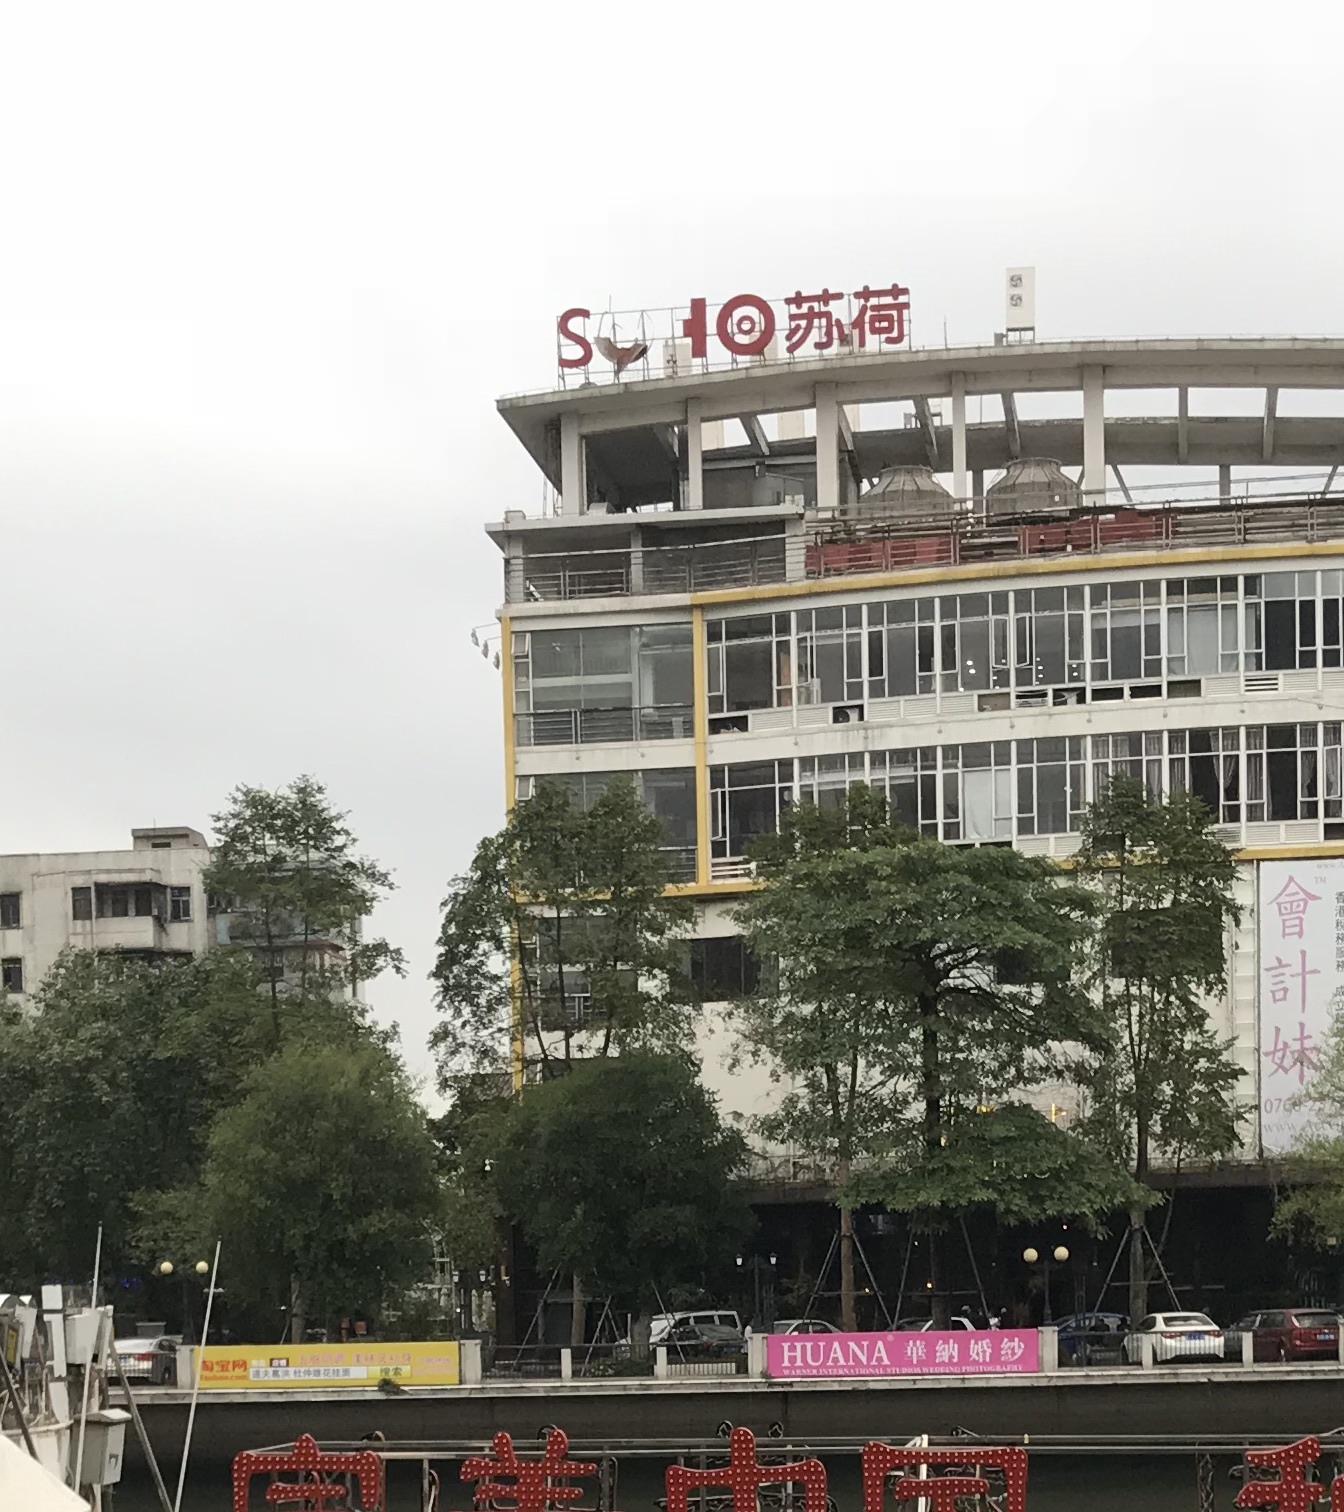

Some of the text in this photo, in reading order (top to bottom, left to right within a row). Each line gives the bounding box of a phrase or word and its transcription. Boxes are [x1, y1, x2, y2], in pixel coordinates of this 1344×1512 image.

[783, 283, 910, 354] 苏荷
[1262, 874, 1324, 1086] 會計妹
[781, 1341, 891, 1367] HUANA
[904, 1336, 1025, 1364] 華納婚紗
[379, 1367, 403, 1377] 搜索
